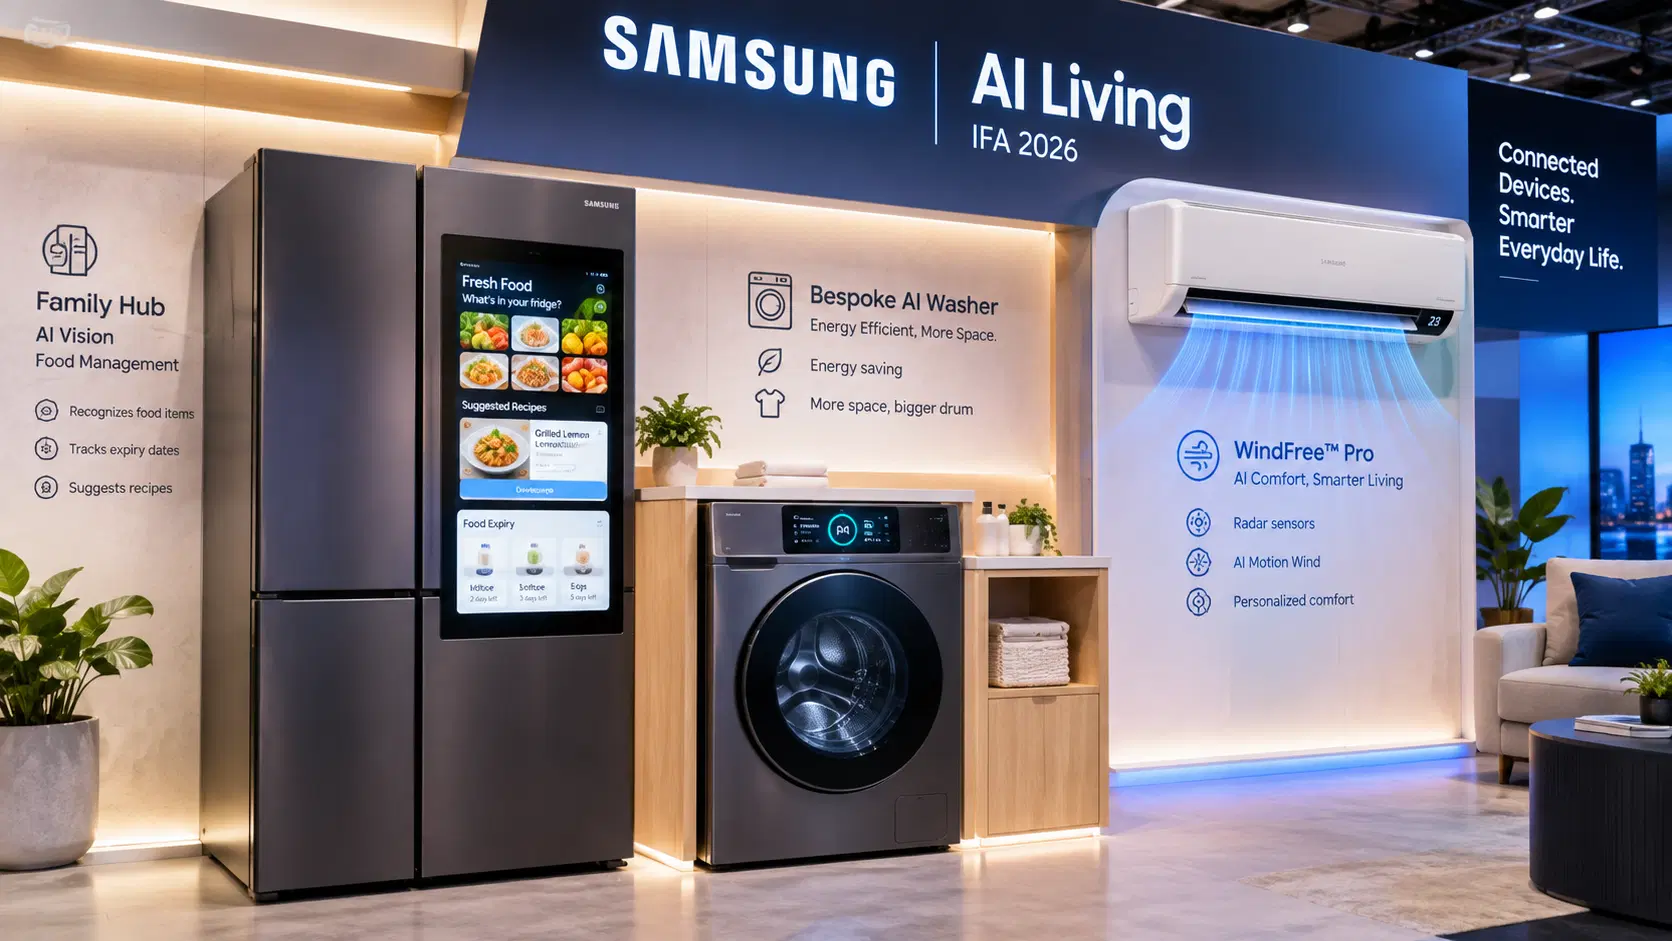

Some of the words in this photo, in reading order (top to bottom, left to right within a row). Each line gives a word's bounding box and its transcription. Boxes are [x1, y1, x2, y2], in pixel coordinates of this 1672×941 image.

[602, 14, 896, 108] SAMSUNG
[971, 52, 1024, 112] AI
[1042, 61, 1192, 150] Living
[972, 123, 1011, 154] IFA
[1018, 130, 1079, 162] 2026
[1499, 141, 1599, 178] Connected
[1499, 172, 1574, 204] Devices.
[1499, 203, 1575, 234] Smarter
[1500, 235, 1585, 270] Everyday
[1589, 246, 1623, 270] Life.
[462, 274, 498, 290] Fresh
[501, 277, 533, 292] Food
[36, 291, 112, 318] Family
[120, 295, 166, 317] Hub
[462, 293, 495, 306] What's
[497, 295, 506, 306] in
[508, 298, 528, 309] your
[530, 297, 562, 311] fridge?
[811, 285, 896, 311] Bespoke
[902, 292, 920, 311] AI
[927, 293, 999, 315] Washer
[36, 326, 54, 343] AI
[60, 327, 114, 345] Vision
[811, 318, 857, 336] Energy
[861, 321, 917, 339] Efficient,
[921, 325, 953, 340] More
[956, 327, 997, 343] Space.
[36, 353, 74, 368] Food
[80, 354, 179, 373] Management
[811, 359, 857, 376] Energy
[861, 361, 903, 379] saving
[69, 405, 134, 420] Recognizes
[136, 406, 162, 420] food
[165, 407, 195, 420] items
[462, 400, 510, 412] Suggested
[512, 402, 547, 413] Recipes
[811, 397, 844, 411] More
[849, 400, 890, 414] space,
[894, 400, 937, 418] bigger
[939, 401, 974, 416] drum
[535, 429, 561, 438] Grilled
[69, 443, 107, 456] Tracks
[110, 444, 145, 459] expiry
[148, 445, 180, 457] dates
[1344, 444, 1374, 462] Pro
[69, 482, 126, 497] Suggests
[129, 482, 172, 497] recipes
[1234, 471, 1247, 485] AI
[1251, 471, 1309, 487] Comfort,
[1313, 472, 1364, 487] Smarter
[1368, 473, 1404, 490] Living
[463, 519, 486, 528] Food
[488, 519, 515, 530] Expiry
[1234, 517, 1268, 529] Radar
[1271, 518, 1315, 530] sensors
[1234, 556, 1245, 568] AI
[1249, 556, 1288, 568] Motion
[1292, 555, 1321, 568] Wind
[1234, 594, 1306, 608] Personalized
[1309, 593, 1354, 607] comfort
